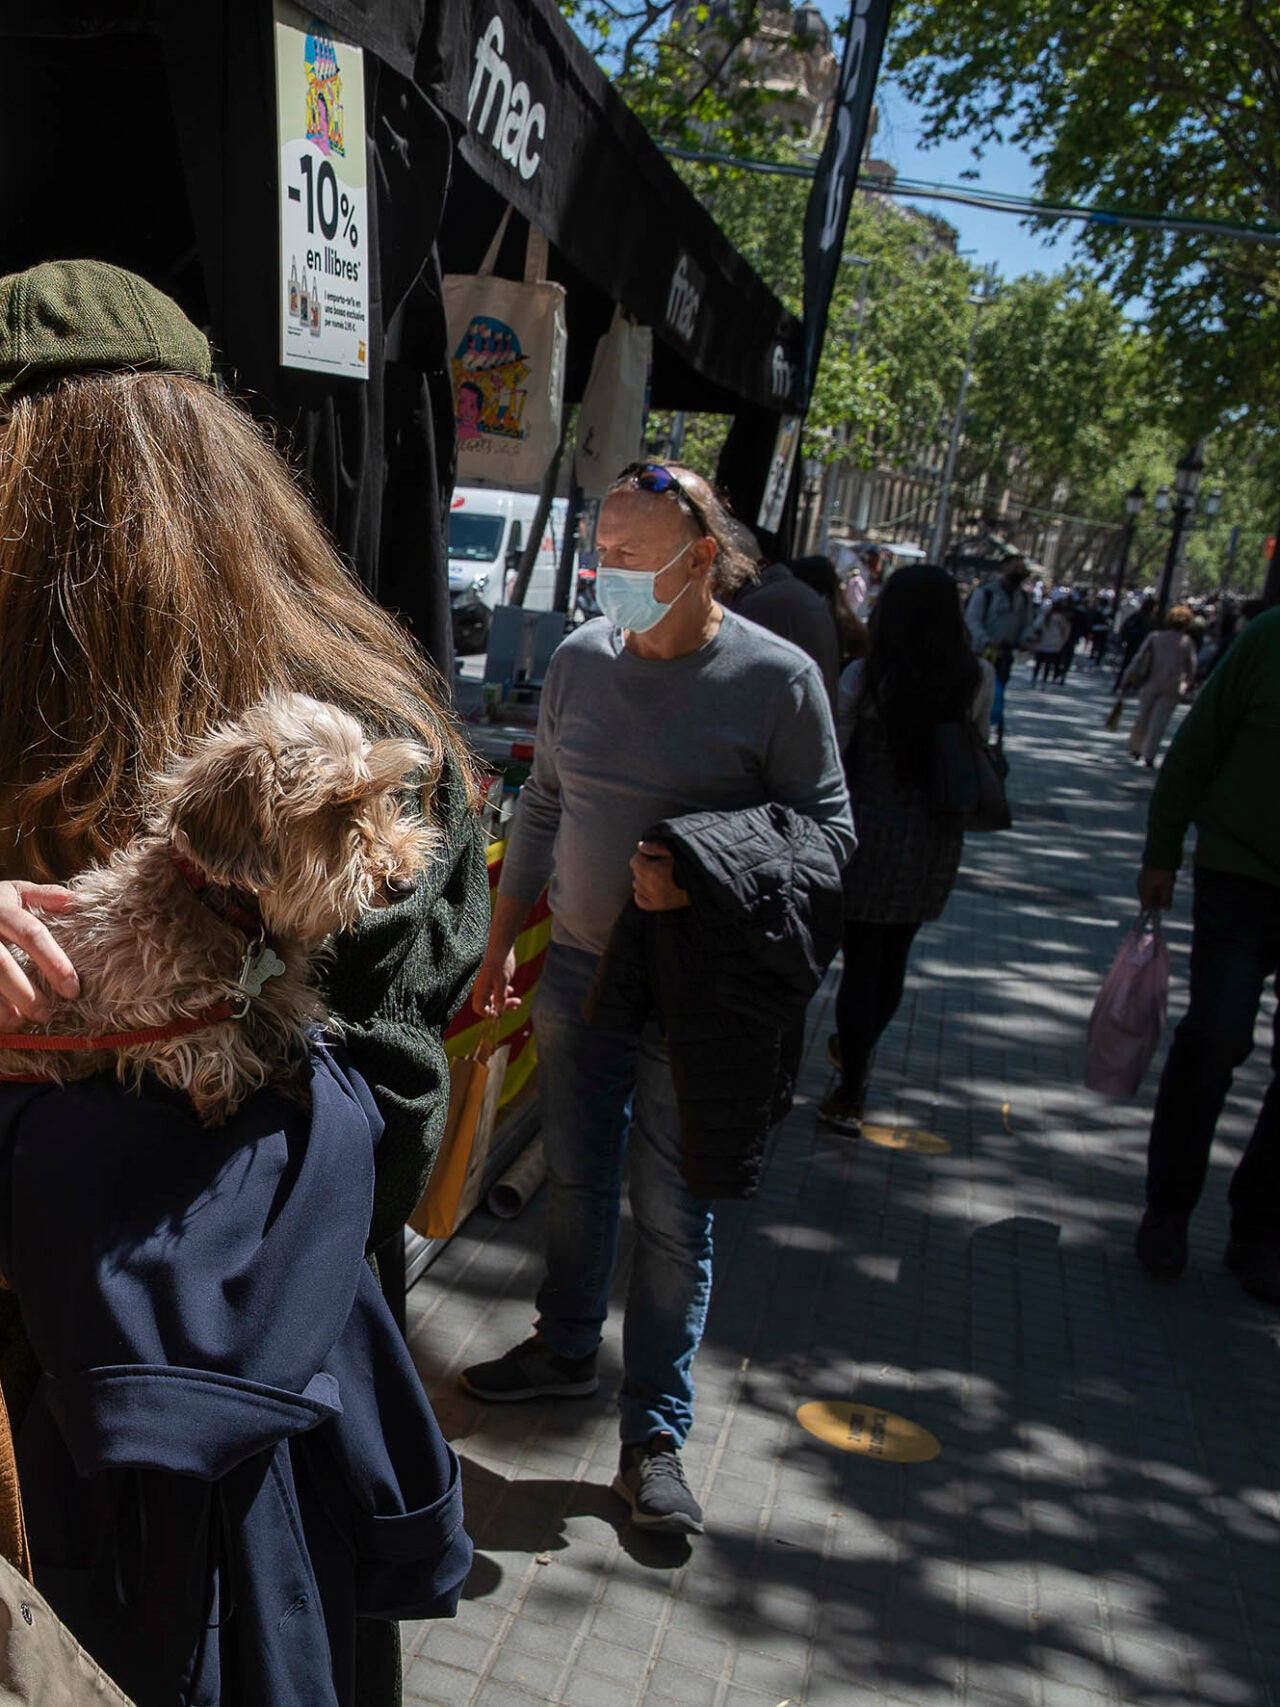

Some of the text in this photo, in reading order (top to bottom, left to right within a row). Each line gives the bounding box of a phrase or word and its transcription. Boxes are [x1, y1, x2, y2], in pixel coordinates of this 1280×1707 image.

[467, 15, 545, 180] fnac
[288, 154, 358, 248] -10%
[307, 249, 321, 271] en
[666, 253, 700, 342] fnac
